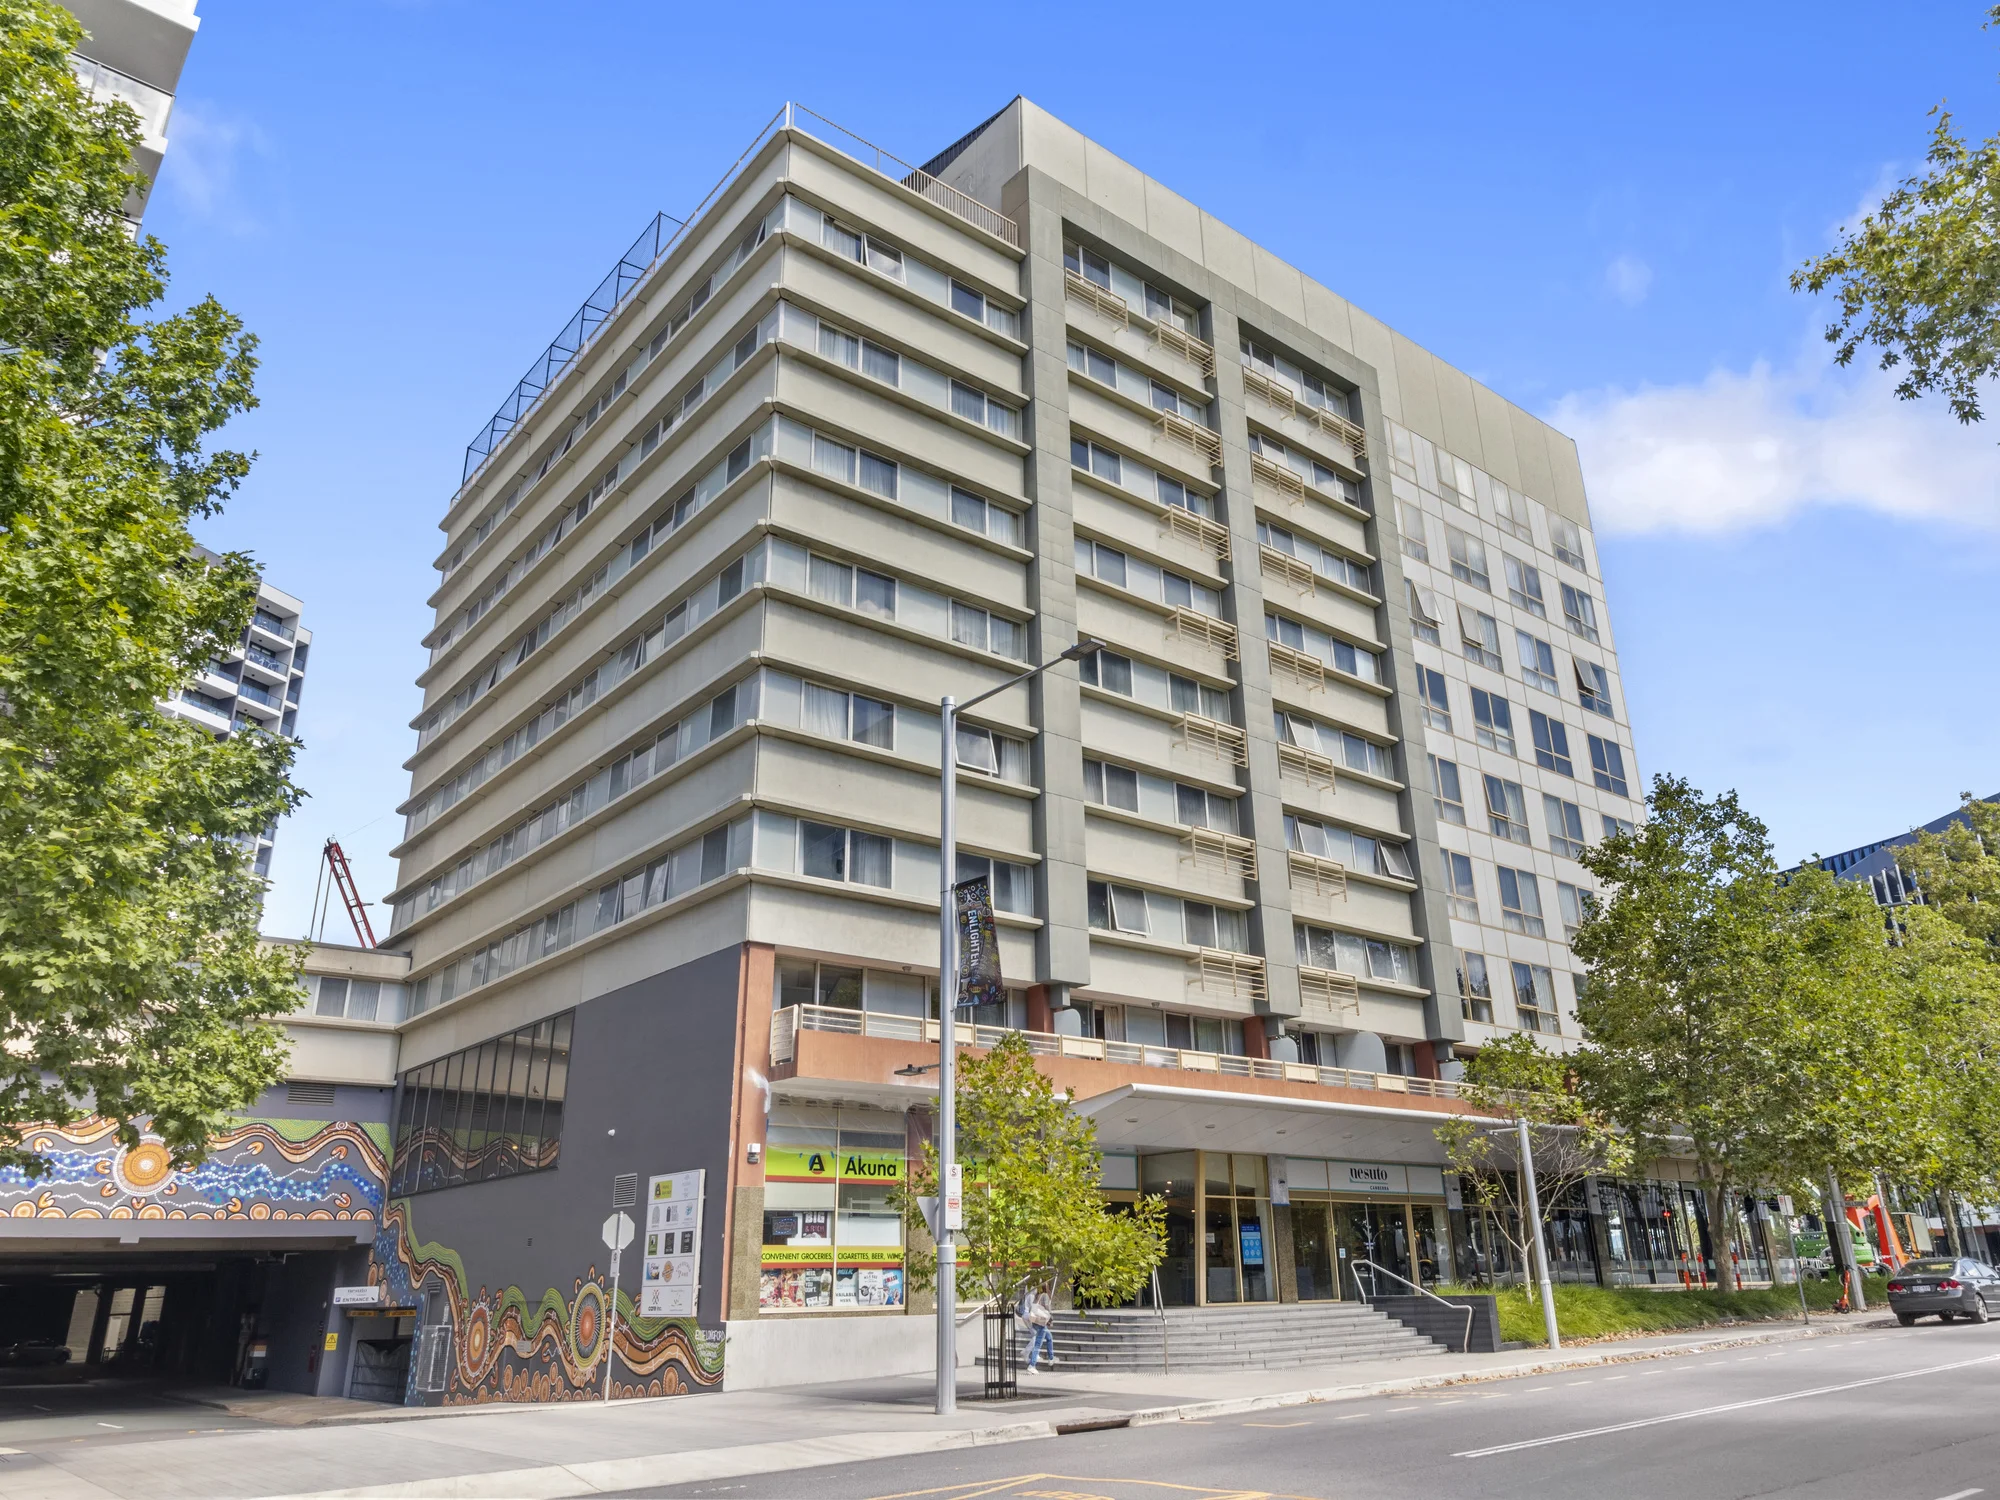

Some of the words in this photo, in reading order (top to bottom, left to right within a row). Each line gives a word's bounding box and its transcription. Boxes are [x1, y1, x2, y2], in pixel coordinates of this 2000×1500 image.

[968, 911, 981, 967] ENLIGHTEN
[844, 1156, 897, 1177] Akuna
[1349, 1166, 1388, 1181] nesuto
[805, 1211, 825, 1223] BIG
[773, 1221, 797, 1231] OPEN
[761, 1252, 800, 1260] CONVENIENT
[800, 1252, 834, 1261] GROCERIES,
[838, 1252, 870, 1261] CIGARETTES,
[871, 1252, 886, 1261] BEER,
